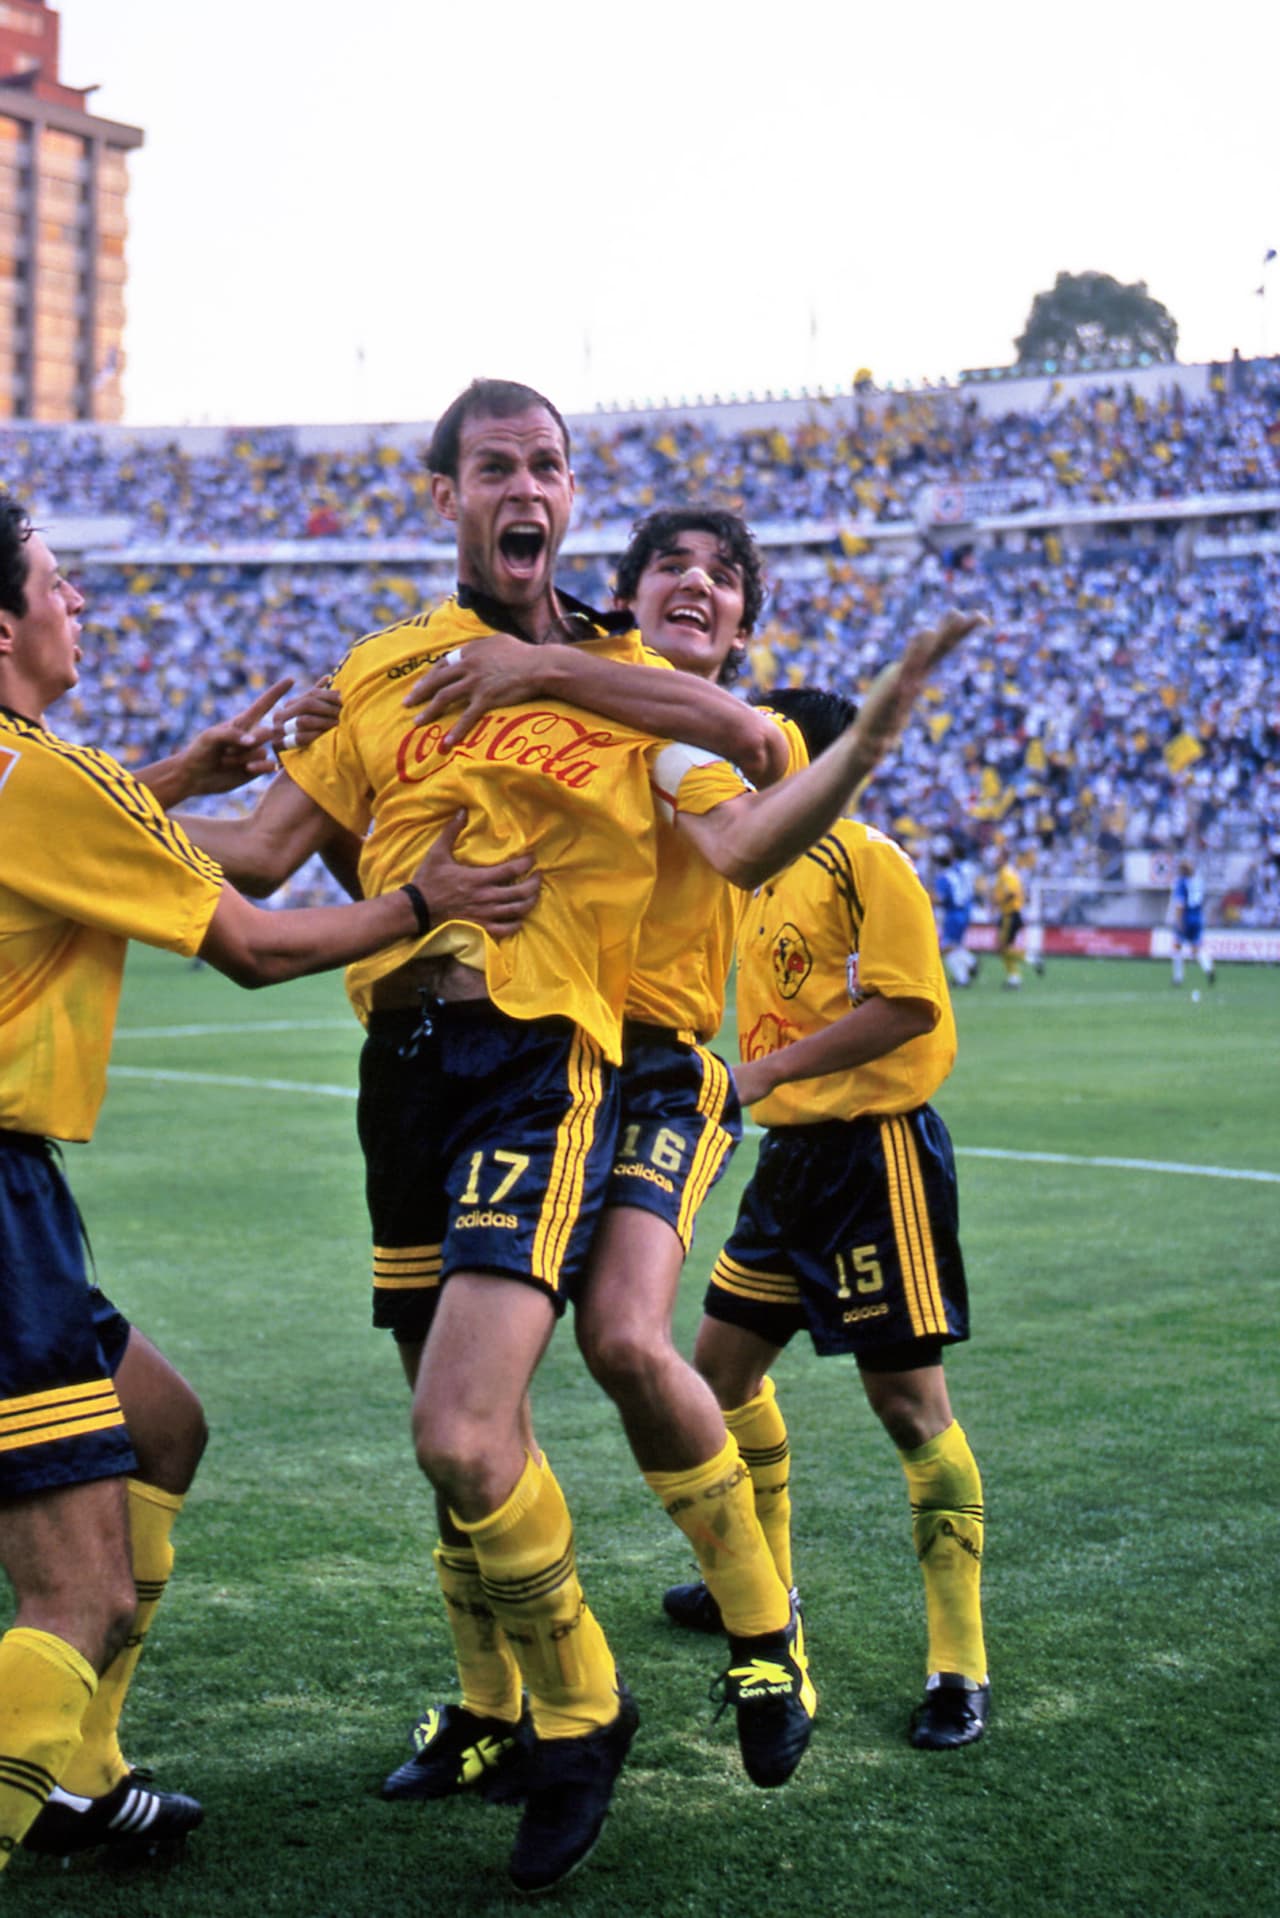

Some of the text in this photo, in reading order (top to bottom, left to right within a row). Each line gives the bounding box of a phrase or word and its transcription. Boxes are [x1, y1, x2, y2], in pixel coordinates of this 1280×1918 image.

[618, 1124, 686, 1172] 16
[459, 1149, 530, 1204] 17
[613, 1163, 674, 1193] adidas
[455, 1210, 518, 1230] adidas
[835, 1243, 884, 1299] 15
